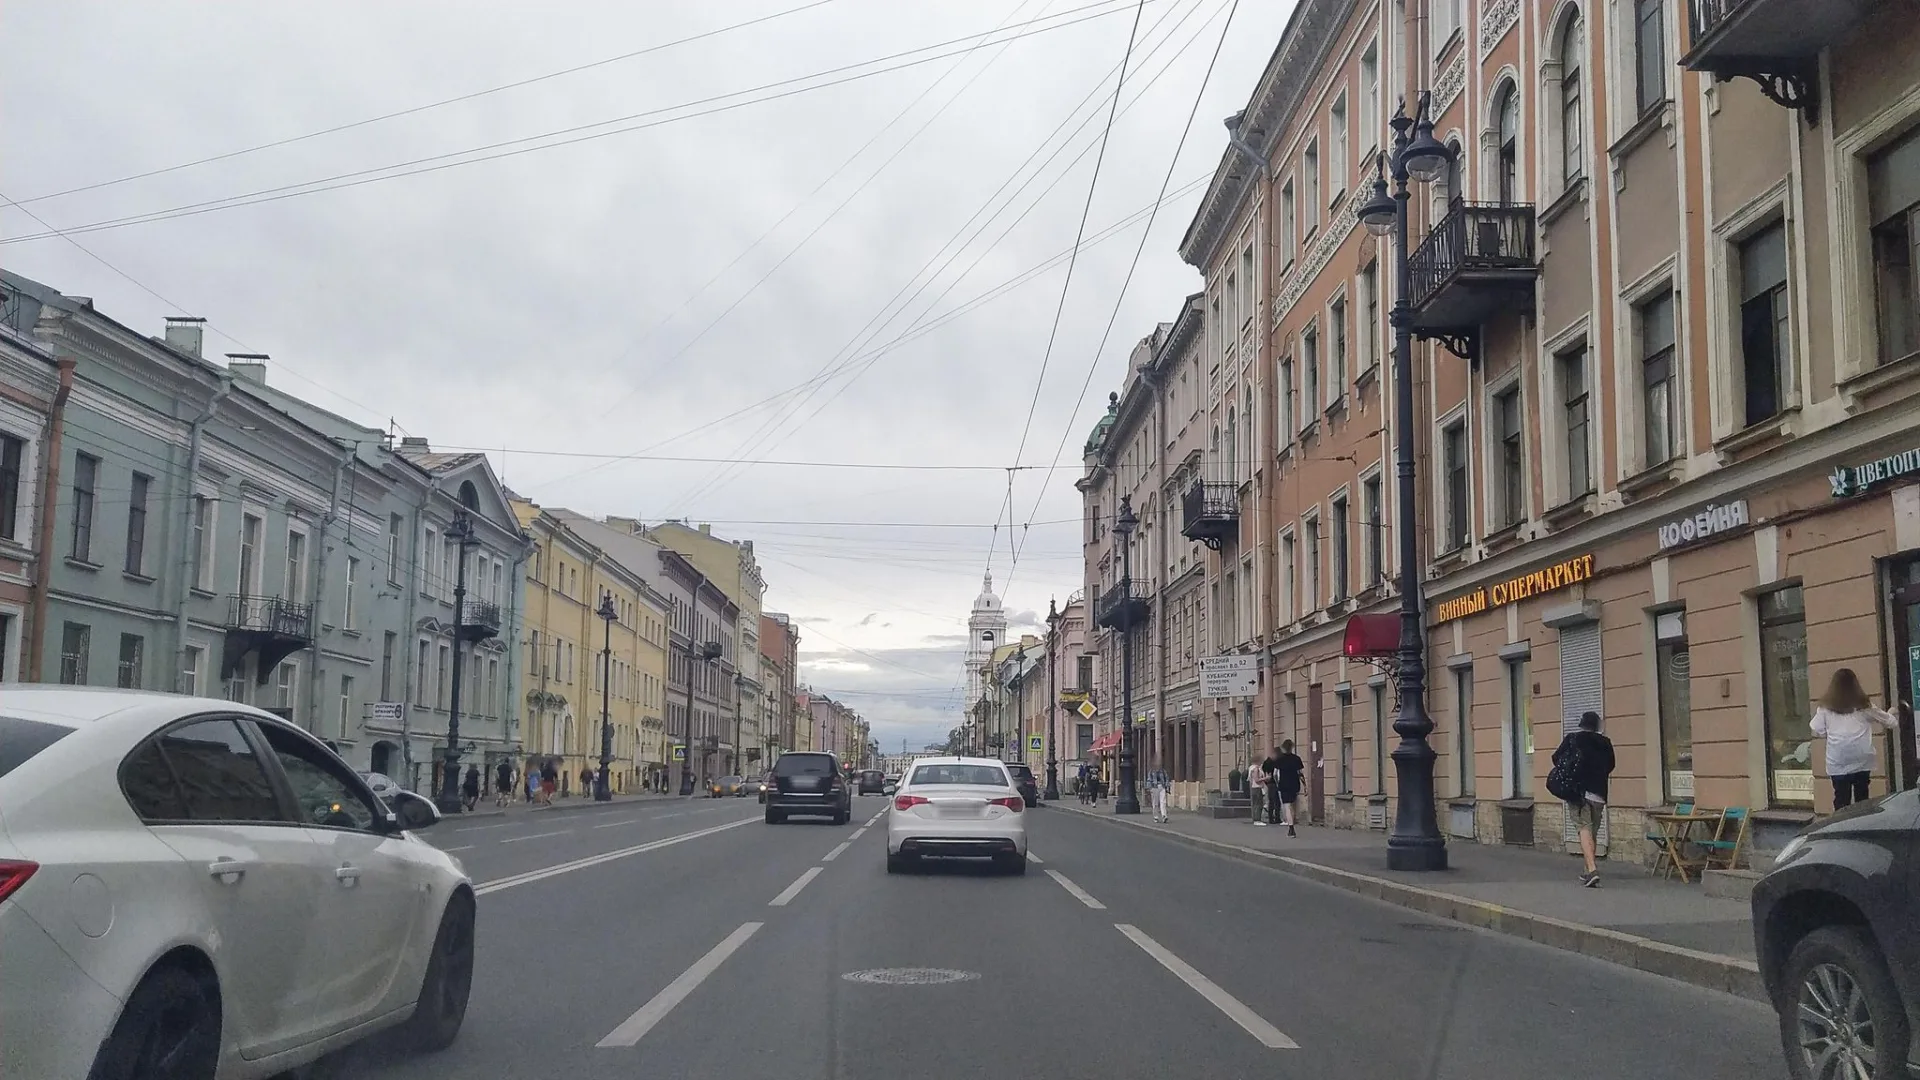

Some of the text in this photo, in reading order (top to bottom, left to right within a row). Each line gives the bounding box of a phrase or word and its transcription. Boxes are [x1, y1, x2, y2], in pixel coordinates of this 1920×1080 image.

[1659, 500, 1748, 549] КОФЕЙНЯ
[1439, 554, 1593, 623] ВИННЫЙ СУПЕРМАРКЕТ
[1207, 671, 1237, 679] КУБАНСКИЙ
